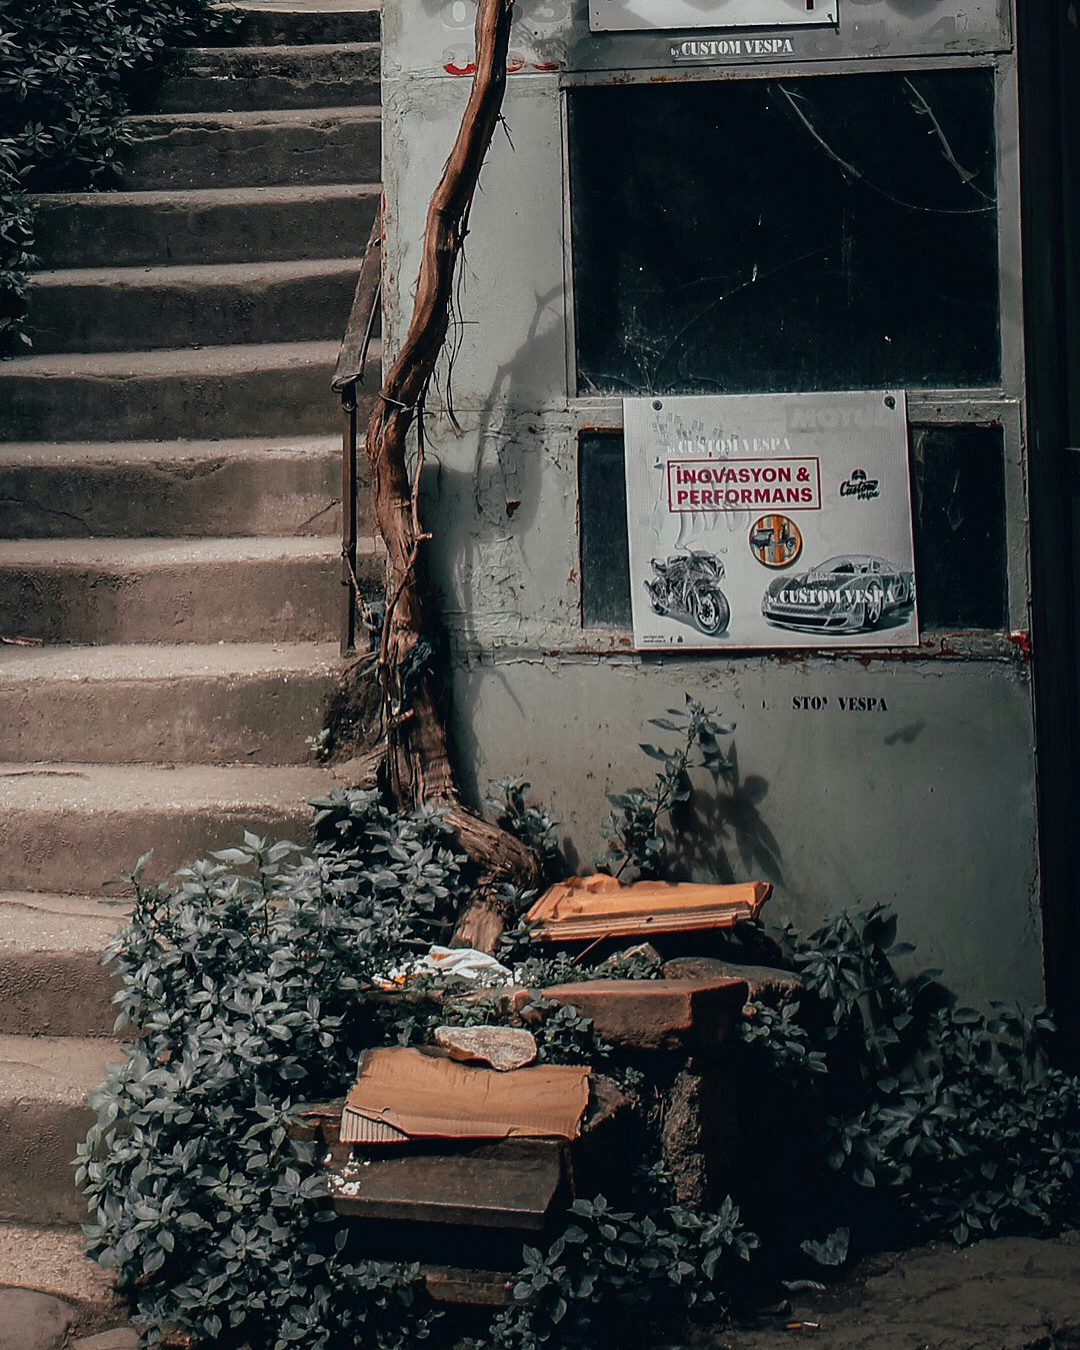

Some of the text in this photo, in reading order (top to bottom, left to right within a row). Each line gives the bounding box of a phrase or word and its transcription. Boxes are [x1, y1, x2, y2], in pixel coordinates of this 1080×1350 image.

[681, 40, 742, 58] CUSTOM
[744, 38, 794, 54] VESPA
[677, 438, 738, 454] CUSTOM
[742, 437, 792, 452] VESPA
[676, 465, 811, 485] İNOVASYON &
[677, 487, 813, 505] PERFORMANS
[779, 589, 842, 603] CUSTOM
[843, 589, 895, 603] VESPA
[838, 697, 888, 712] VESPA
